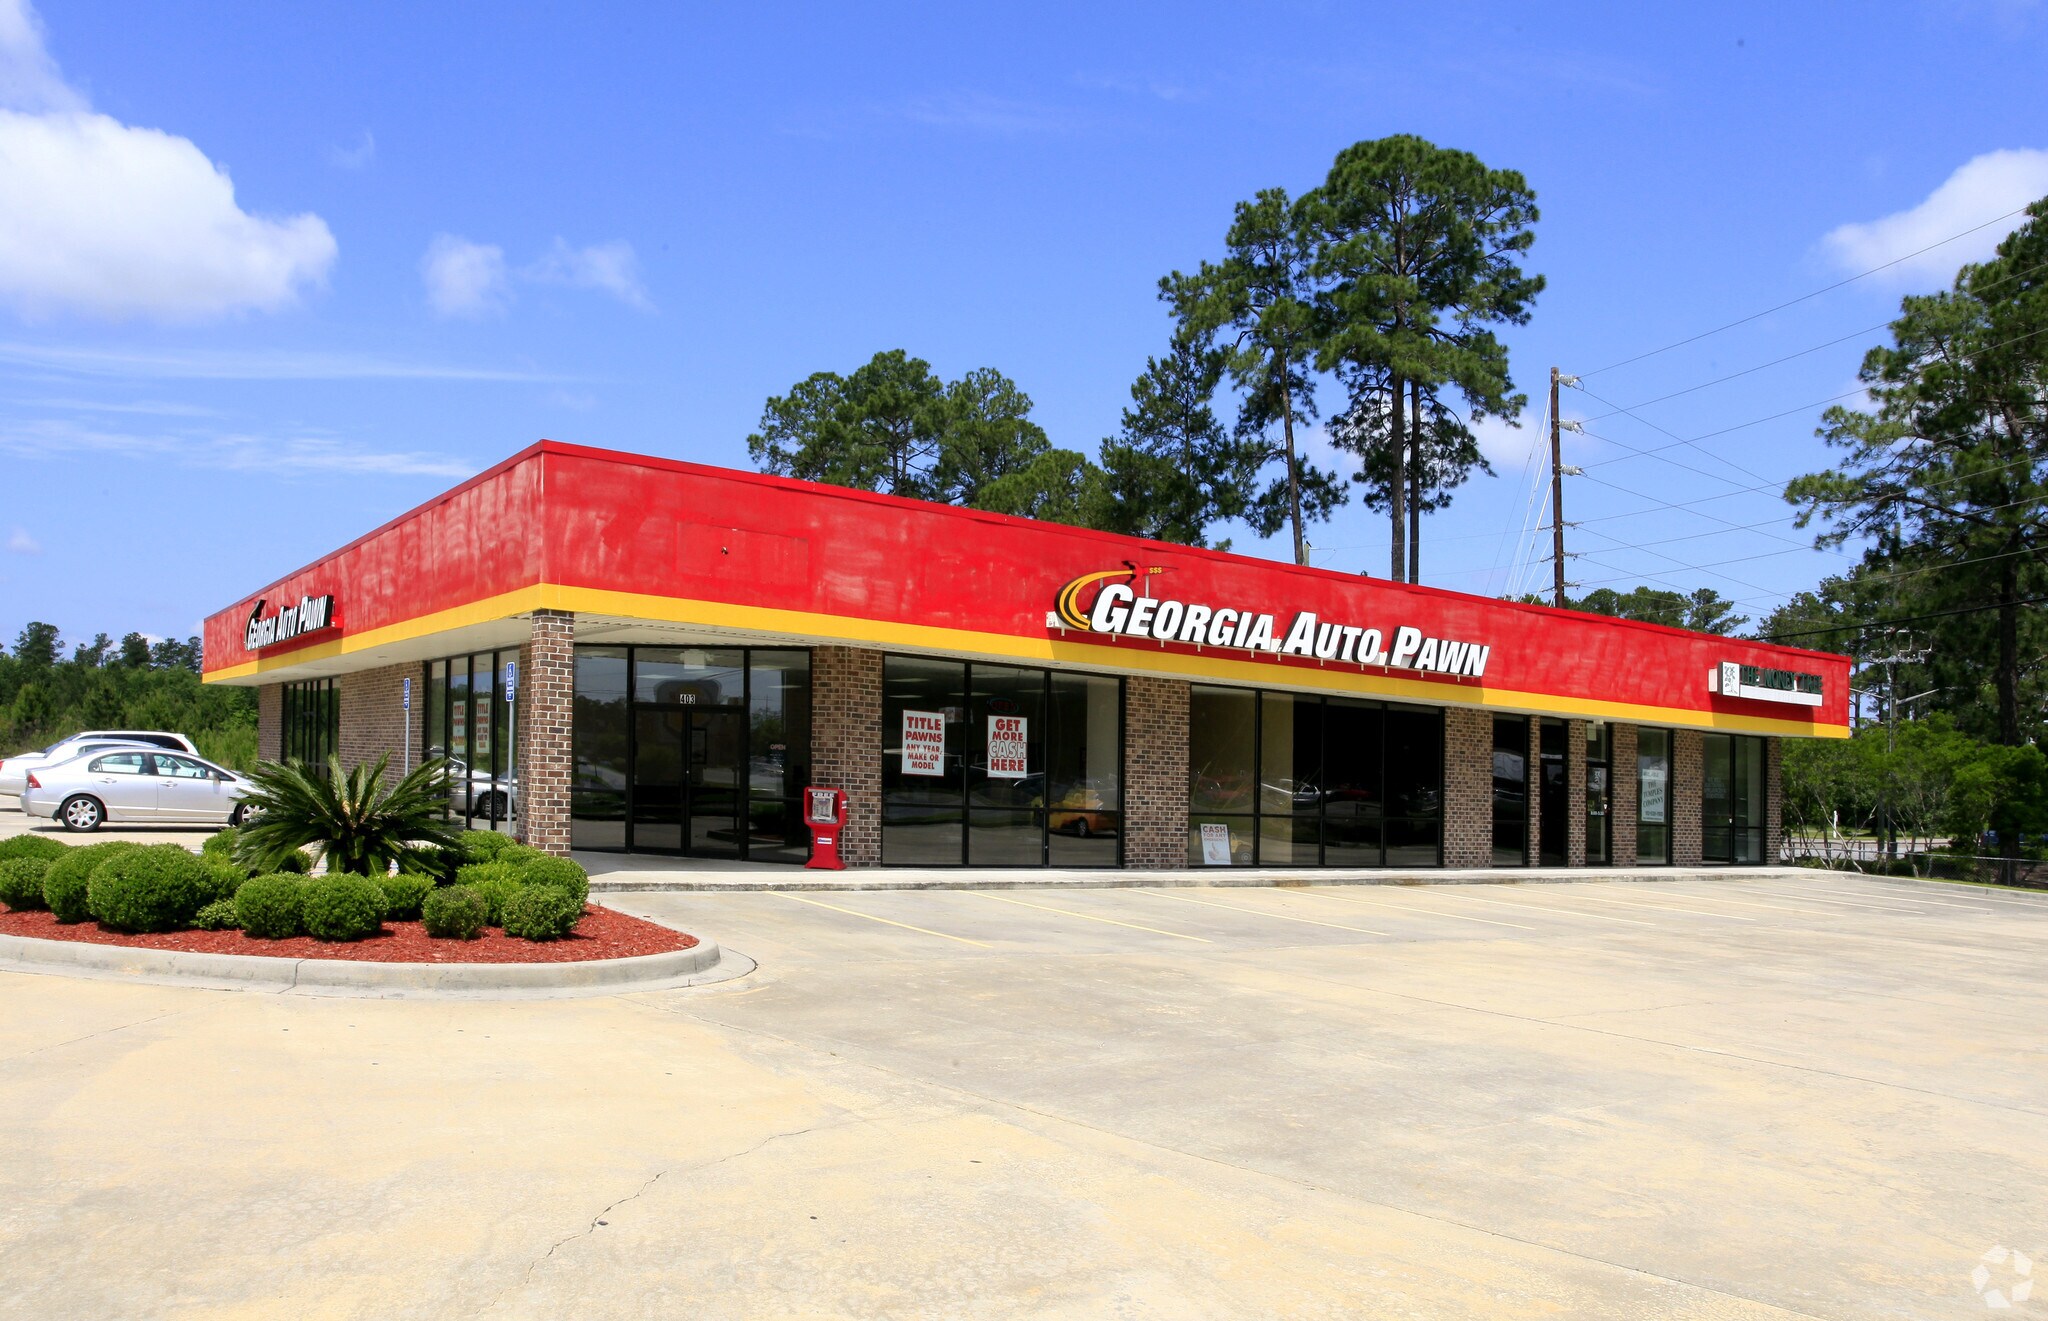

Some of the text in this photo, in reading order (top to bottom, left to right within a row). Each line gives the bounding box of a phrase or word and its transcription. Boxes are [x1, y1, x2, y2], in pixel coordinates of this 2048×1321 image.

[247, 595, 328, 651] GEORGIA AUTO PAWN
[1090, 583, 1490, 677] GEORGIA AUTO PAWN
[1740, 665, 1823, 695] THE MONEY TREE
[681, 694, 695, 703] 403
[907, 716, 942, 731] TITLE
[995, 719, 1021, 731] GET
[905, 731, 942, 743] PAWNS
[992, 731, 1023, 741] MORE
[988, 741, 1027, 759] CASH
[908, 752, 927, 761] MAKE
[911, 761, 935, 769] MODEL
[991, 759, 1024, 771] HERE
[1203, 825, 1226, 833] CASH
